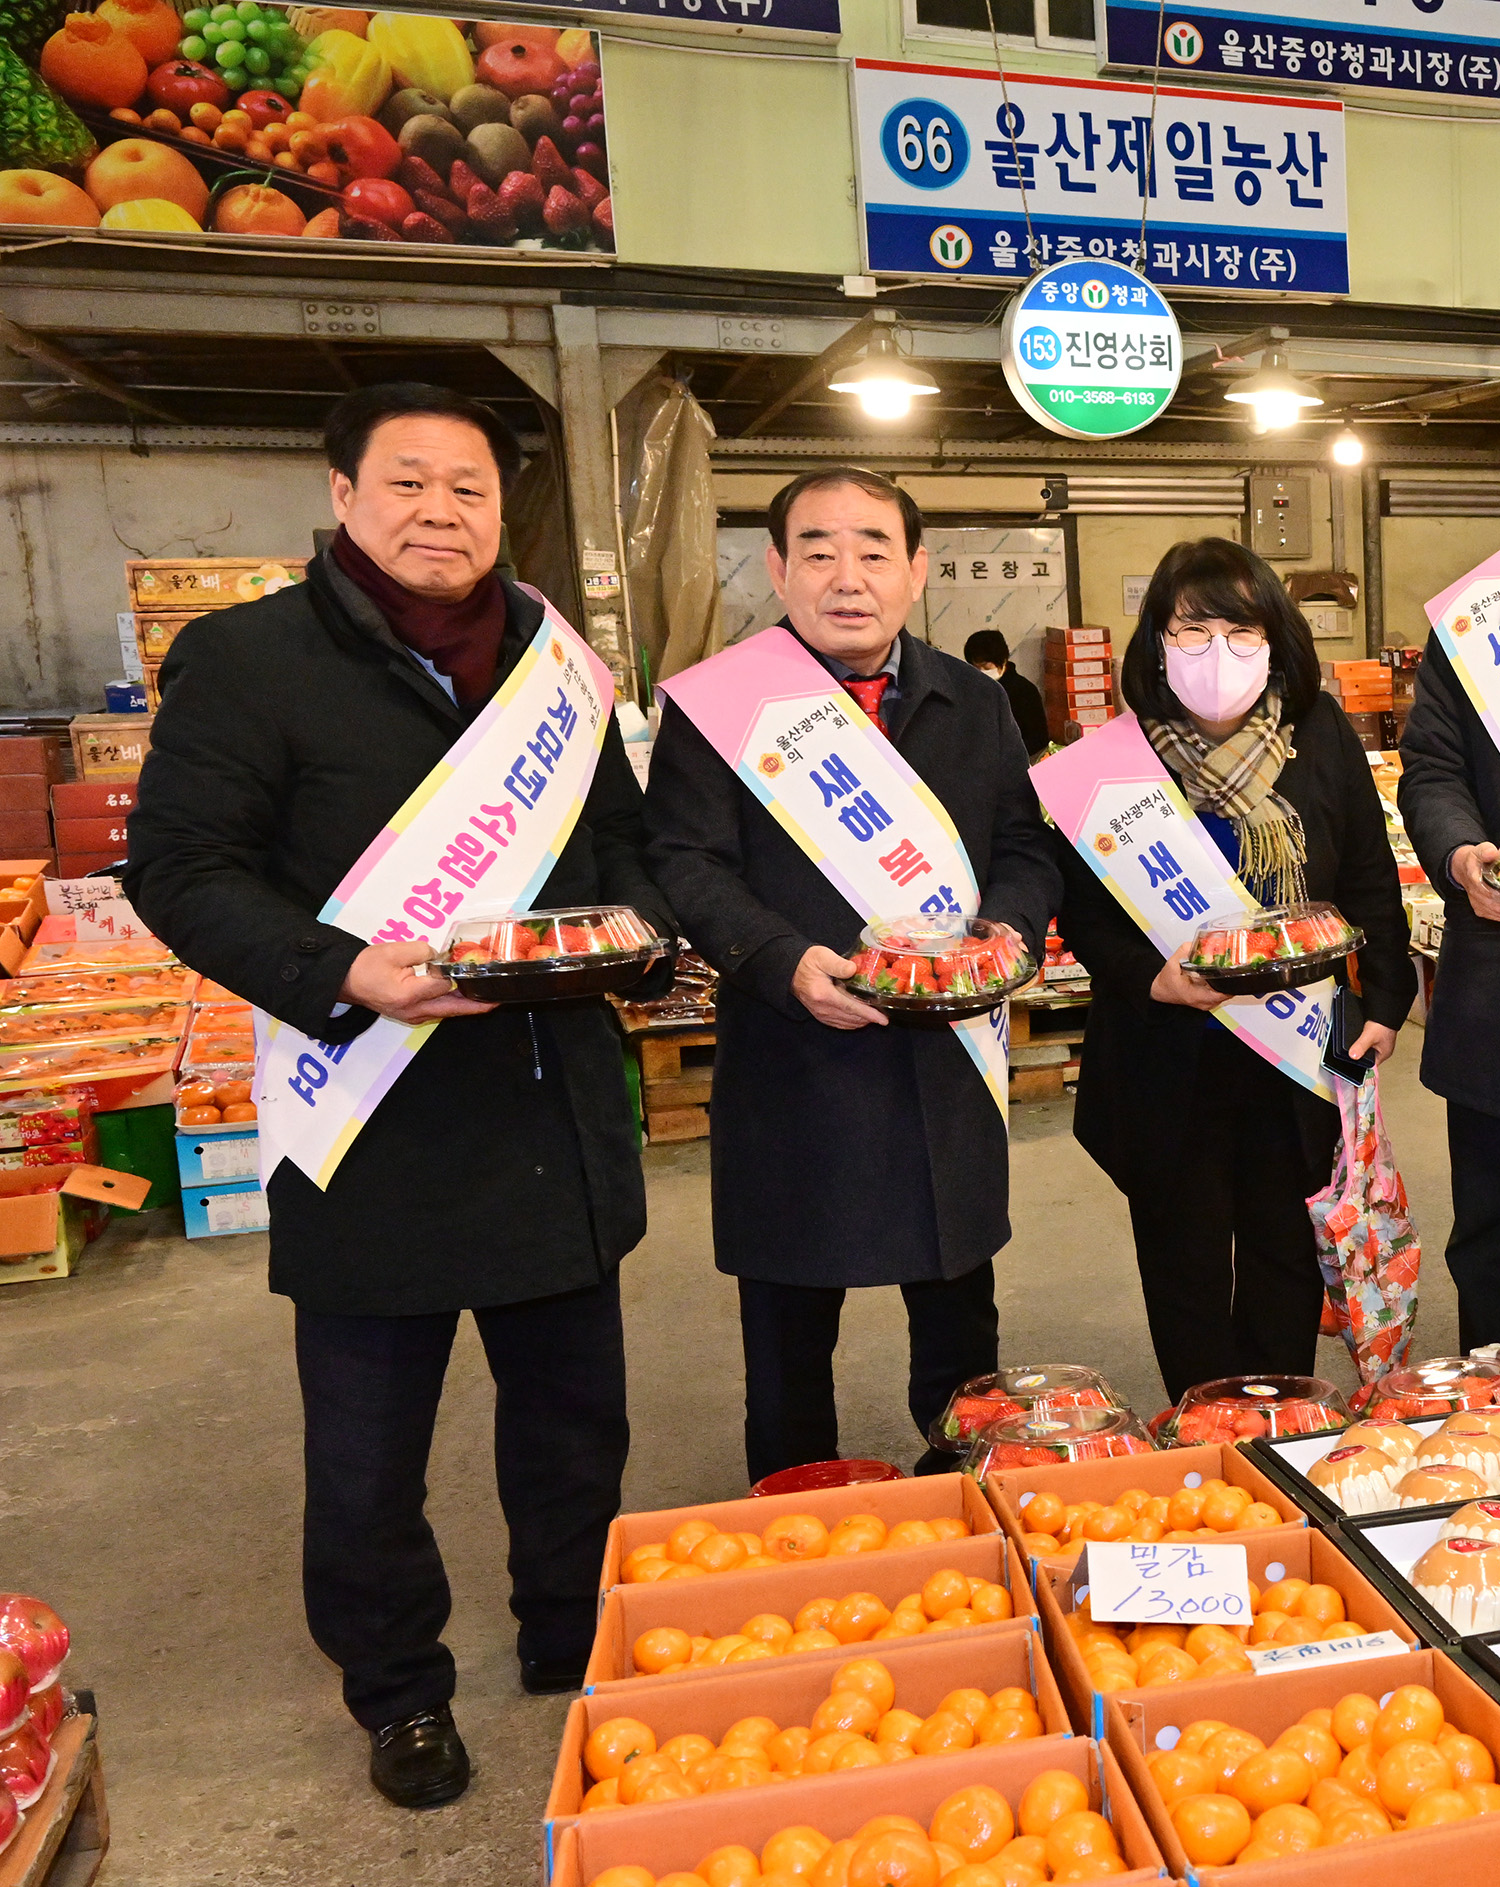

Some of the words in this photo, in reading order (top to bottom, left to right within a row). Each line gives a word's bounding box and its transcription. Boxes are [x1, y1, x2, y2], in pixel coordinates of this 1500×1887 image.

[896, 114, 955, 173] 66
[985, 101, 1328, 209] 울산제일농산
[1041, 281, 1079, 303] 중앙
[1111, 284, 1149, 307] 청과
[1022, 333, 1057, 362] 153
[1066, 330, 1173, 371] 진영상회
[1049, 389, 1156, 406] 010-3568-6193
[775, 701, 839, 752] 울산광역시
[503, 687, 578, 811] 계묘년
[106, 794, 132, 807] 名品
[809, 752, 894, 842] 새해
[878, 838, 933, 887] 복
[1109, 789, 1166, 833] 울산광역시
[1137, 840, 1211, 921] 새해
[1131, 1544, 1214, 1579] 밀감
